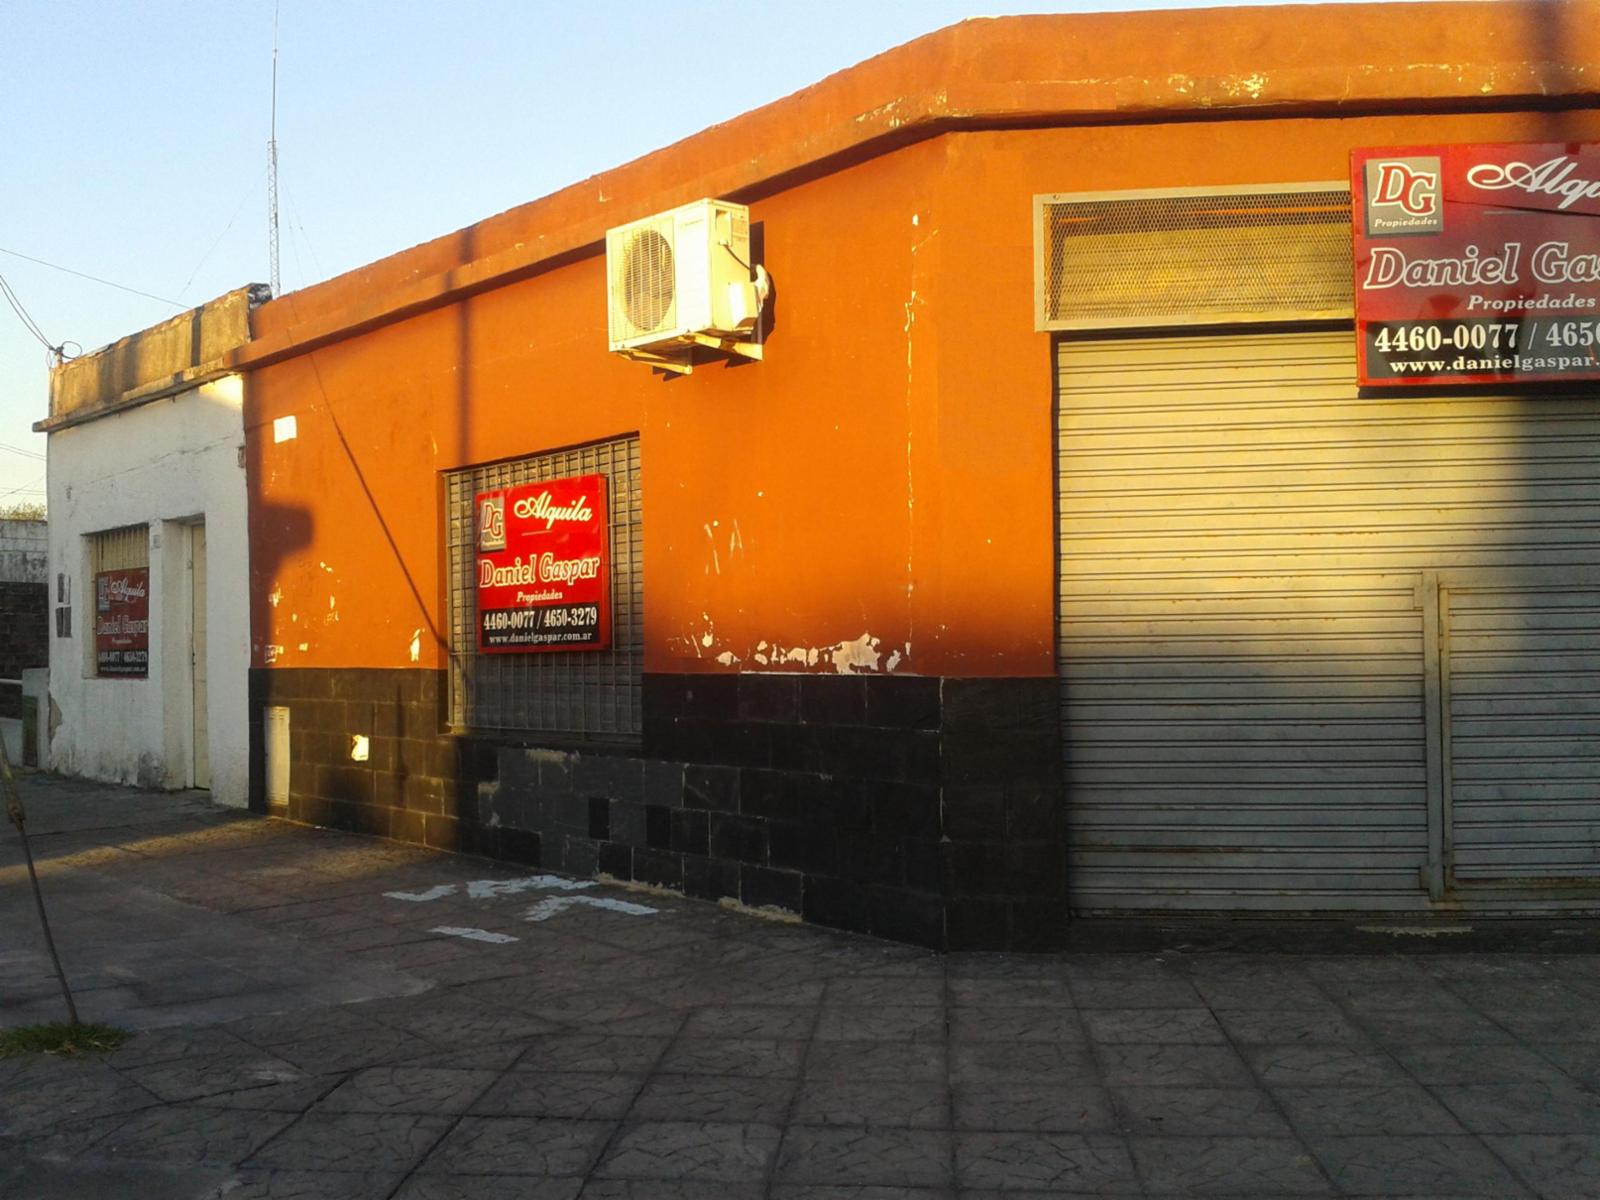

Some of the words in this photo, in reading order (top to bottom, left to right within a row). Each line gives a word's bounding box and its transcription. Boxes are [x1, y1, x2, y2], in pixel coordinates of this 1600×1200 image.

[1372, 162, 1437, 216] DG
[1374, 217, 1438, 228] Propiedades
[1363, 242, 1521, 289] Daniel
[1531, 241, 1600, 283] Ga
[1467, 293, 1596, 312] Propiedades
[1374, 323, 1520, 353] 4460-0077
[1545, 321, 1600, 347] 465
[1390, 355, 1600, 373] www.danielgaspar.
[481, 502, 503, 539] DG
[514, 490, 592, 529] Alquila
[480, 554, 537, 588] Daniel
[538, 552, 600, 586] Gaspar
[516, 589, 563, 603] Propiedades
[483, 610, 535, 630] 4460-0077
[544, 606, 597, 628] 4650-3279
[488, 632, 593, 645] www.danielgaspar.com.ar
